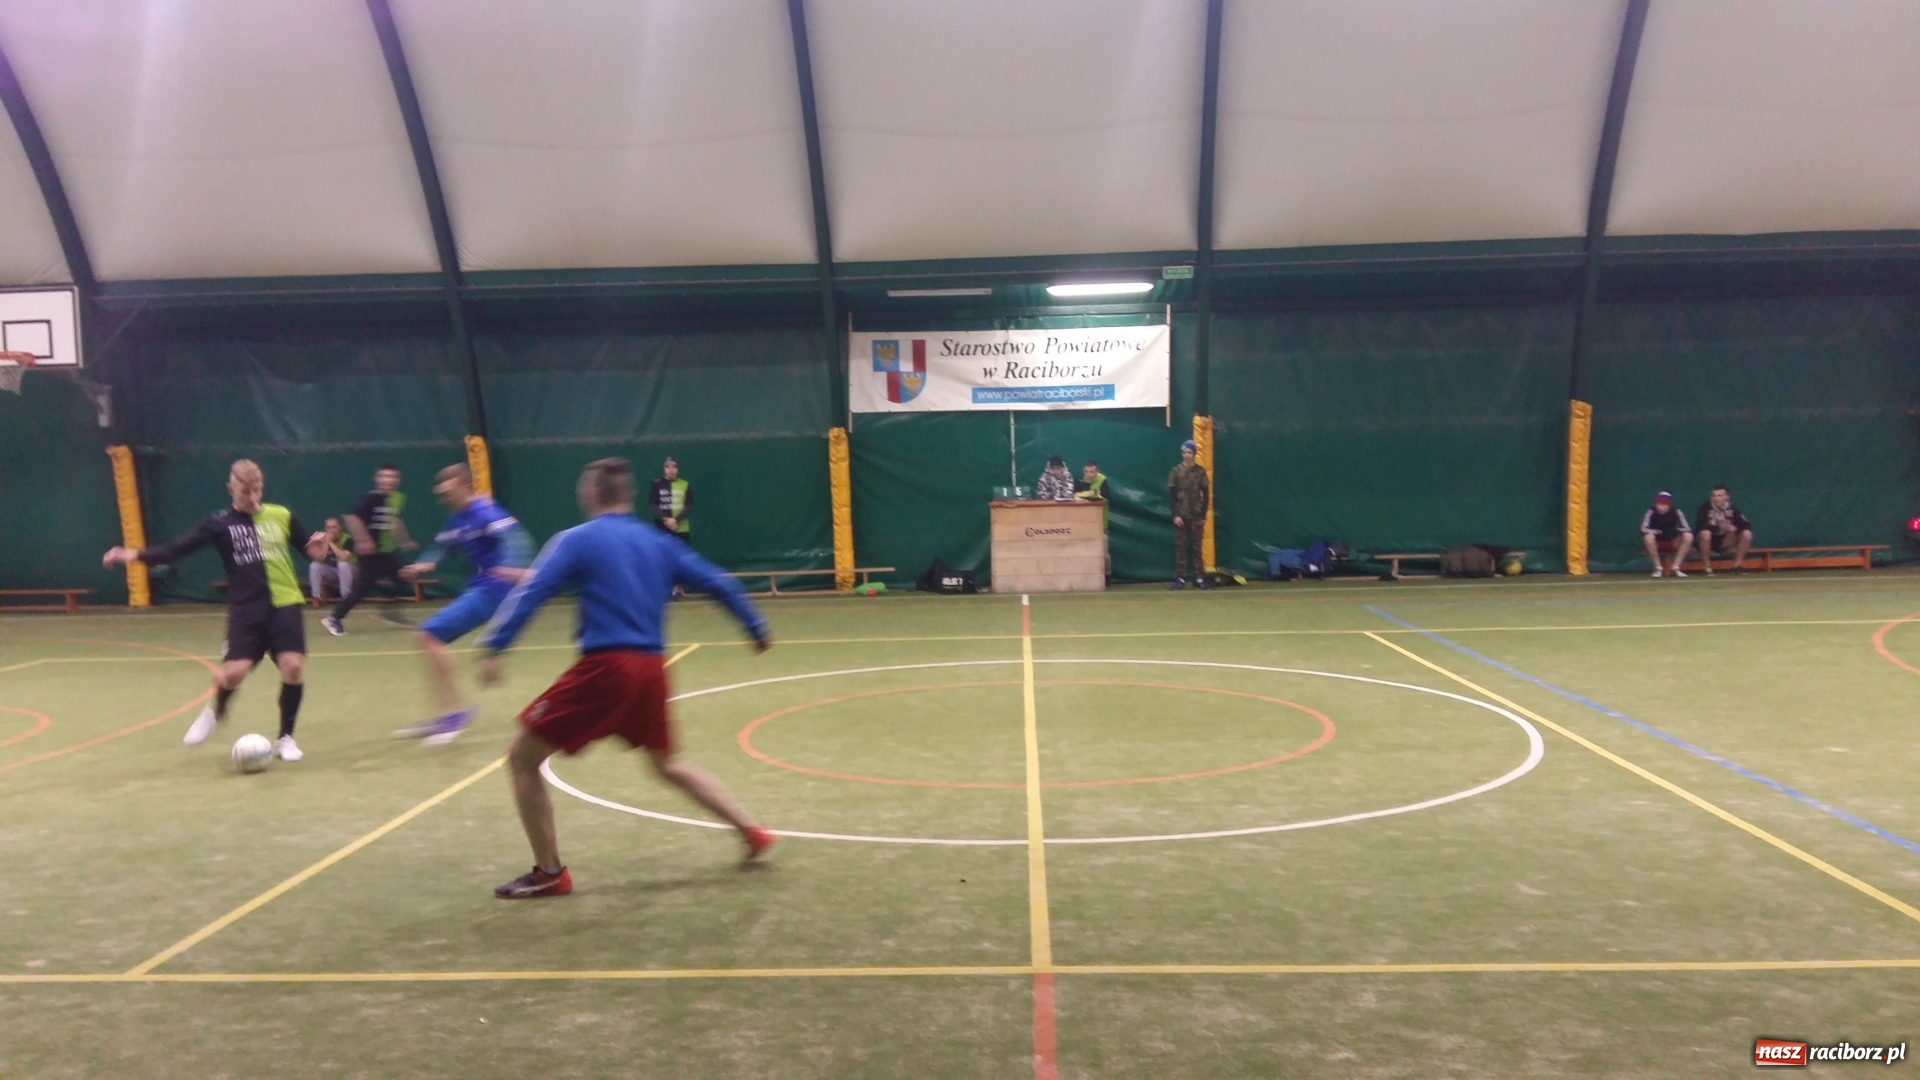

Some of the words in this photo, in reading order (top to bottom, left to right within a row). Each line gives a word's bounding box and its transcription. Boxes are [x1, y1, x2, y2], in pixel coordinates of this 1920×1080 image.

[940, 338, 1035, 357] Starostwo
[1044, 336, 1147, 355] Powiatowe
[982, 367, 998, 379] w
[1004, 360, 1103, 379] Raciborzu
[976, 386, 1105, 401] www.powiatraciborski.pl
